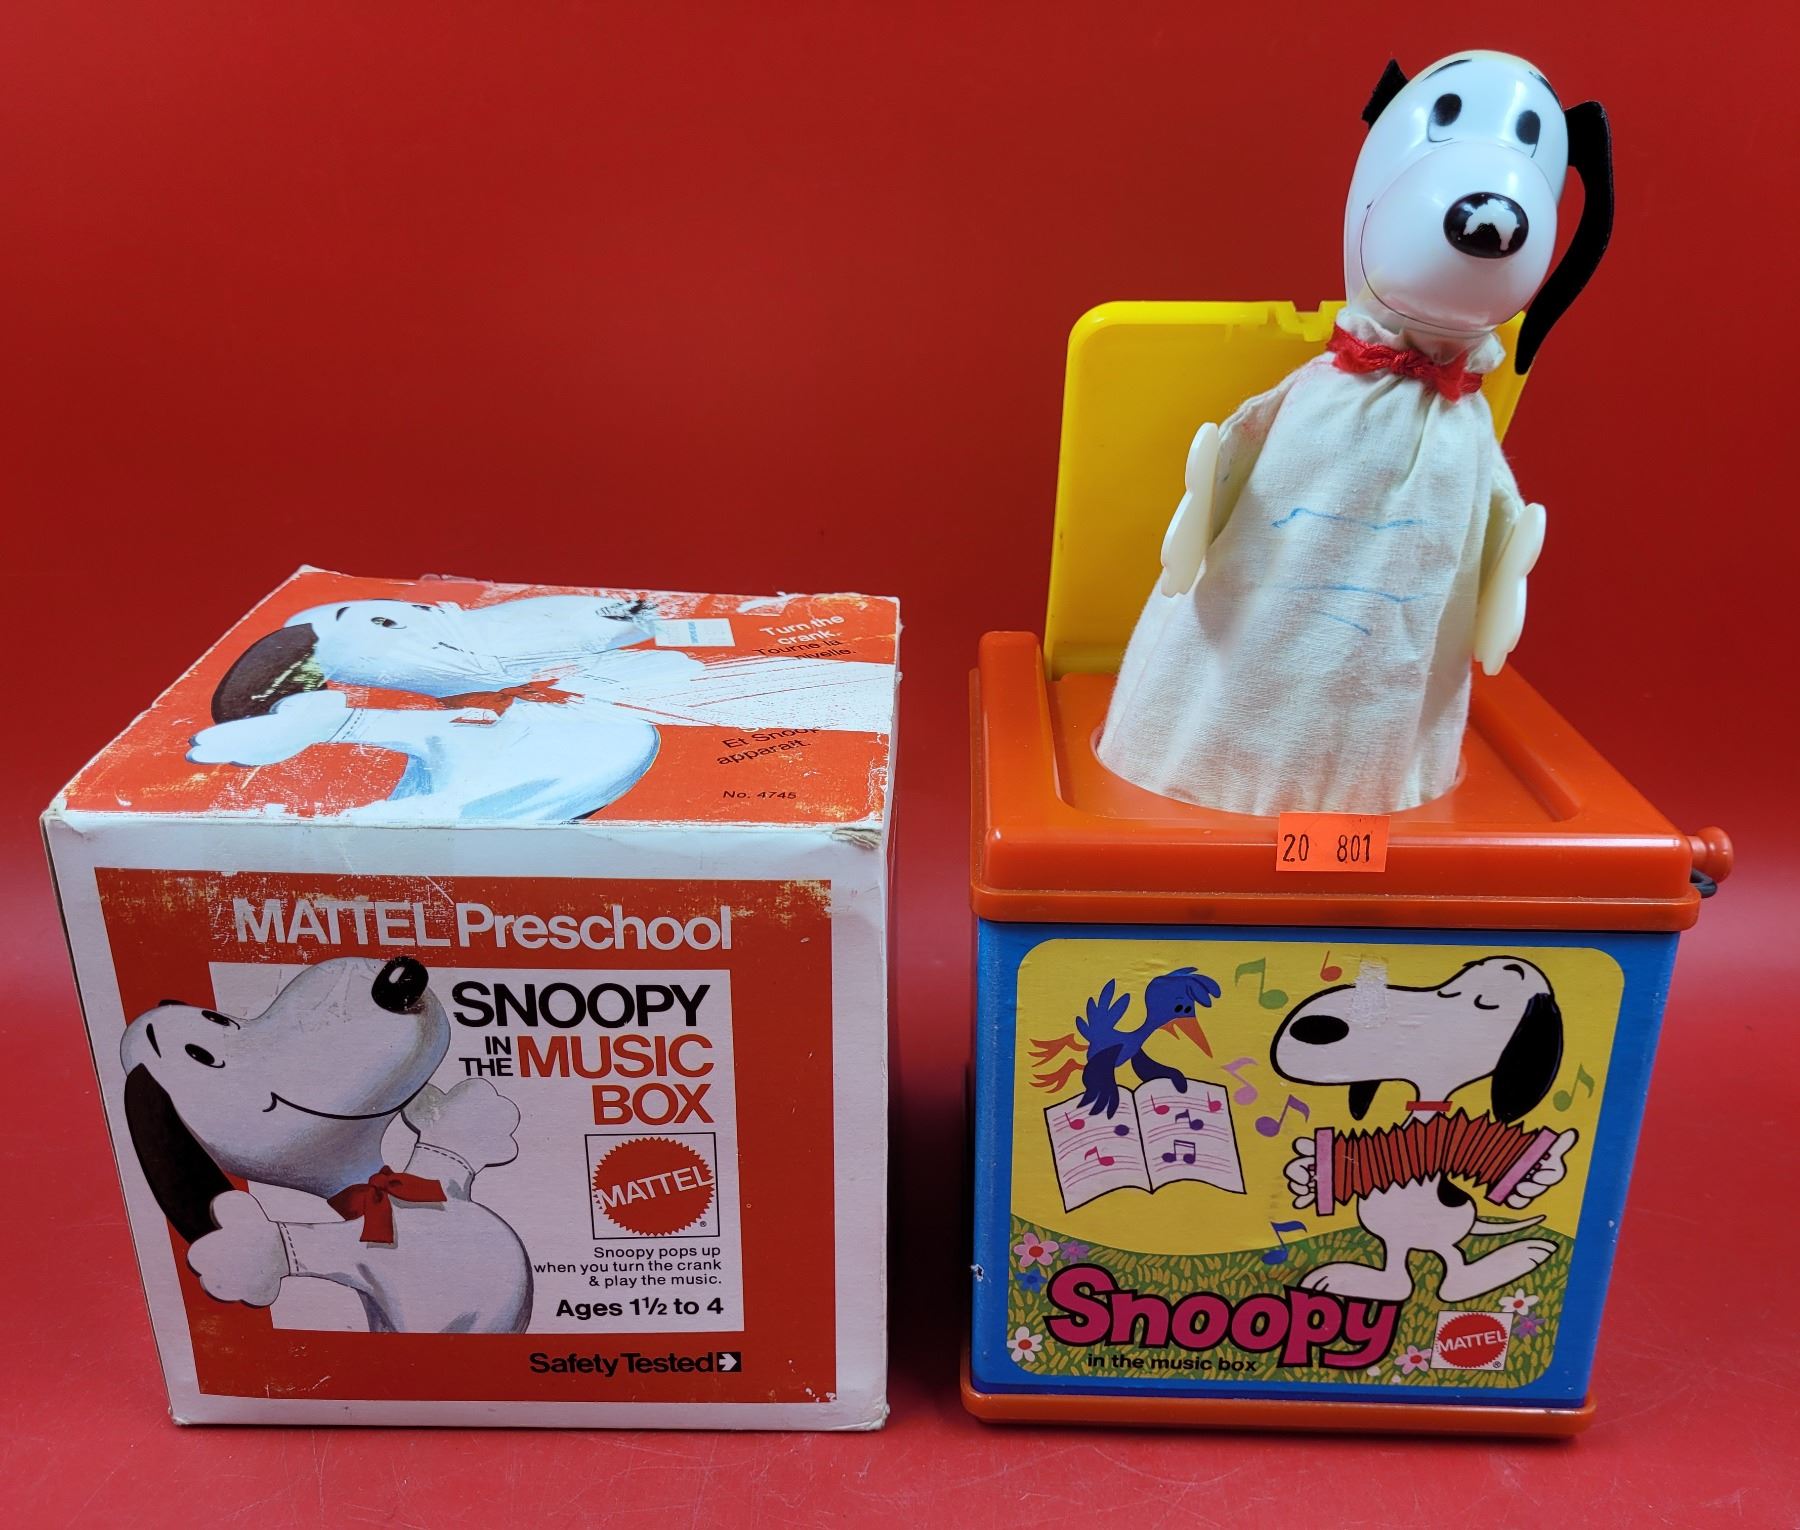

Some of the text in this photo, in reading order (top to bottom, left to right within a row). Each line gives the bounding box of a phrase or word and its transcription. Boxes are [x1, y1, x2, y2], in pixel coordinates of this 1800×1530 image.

[759, 615, 845, 637] Turn the
[752, 639, 843, 656] Tourne la
[777, 630, 842, 645] crank.
[722, 737, 749, 748] Et
[723, 790, 797, 799] No. 4745
[1282, 833, 1371, 863] 20 801
[233, 898, 732, 952] MATTEL Preschool
[452, 980, 711, 1029] SNOOPY
[458, 1034, 714, 1079] THE MUSIC
[484, 1036, 512, 1056] IN
[592, 1083, 714, 1126] BOX
[596, 1165, 716, 1211] MATTEL
[593, 1247, 721, 1260] Snoopy pops up
[534, 1260, 722, 1276] when you turn the crank
[588, 1274, 722, 1290] & play the music.
[556, 1299, 623, 1321] Ages
[674, 1299, 700, 1316] to
[707, 1297, 724, 1315] 4
[1043, 1262, 1400, 1370] Snoopy
[1437, 1330, 1509, 1353] MATTEL
[529, 1351, 714, 1378] Safety Tested
[1087, 1353, 1257, 1372] in the music box
